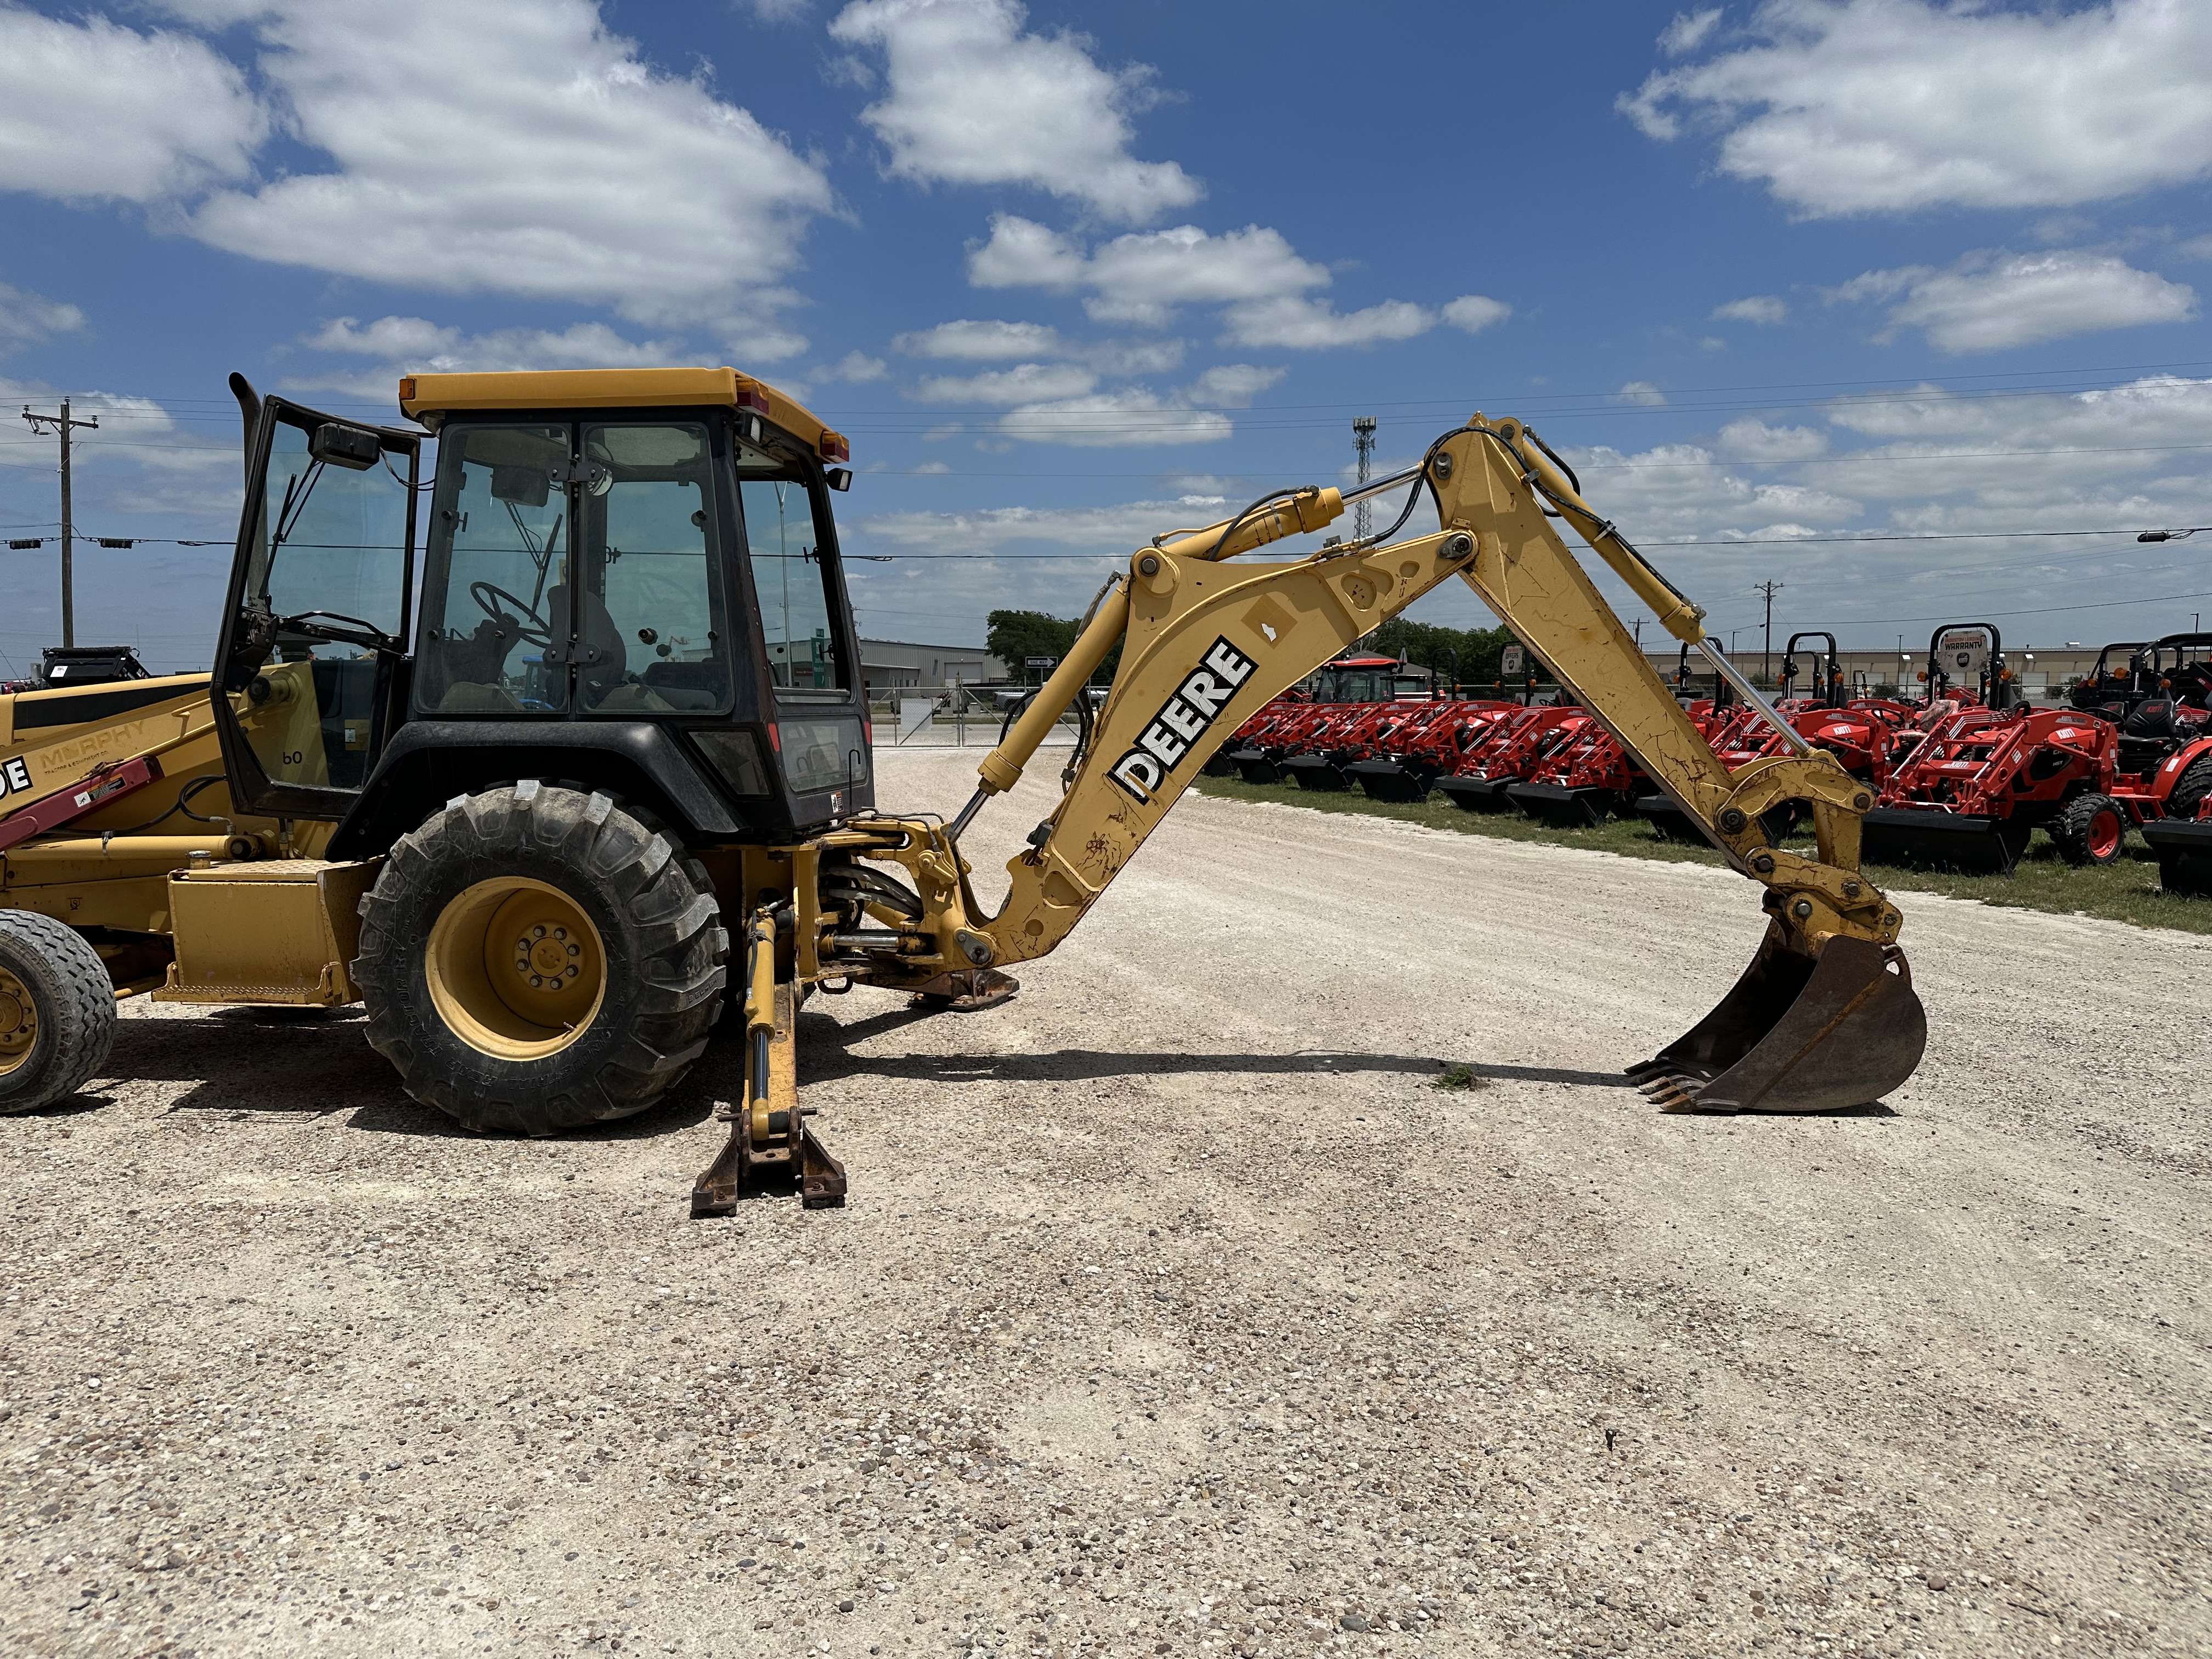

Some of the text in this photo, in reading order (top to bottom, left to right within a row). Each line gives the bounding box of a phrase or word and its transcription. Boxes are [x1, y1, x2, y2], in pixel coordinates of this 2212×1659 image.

[1945, 641, 1982, 650] WARRANTY
[1114, 642, 1252, 798] DEERE
[1833, 725, 1852, 736] KIOTI
[2056, 728, 2076, 740] KIOTI
[44, 763, 67, 775] TRACTOR
[72, 754, 100, 766] EQUIPMENT
[396, 978, 443, 1058] TRACTOR
[444, 1057, 498, 1087] REAR
